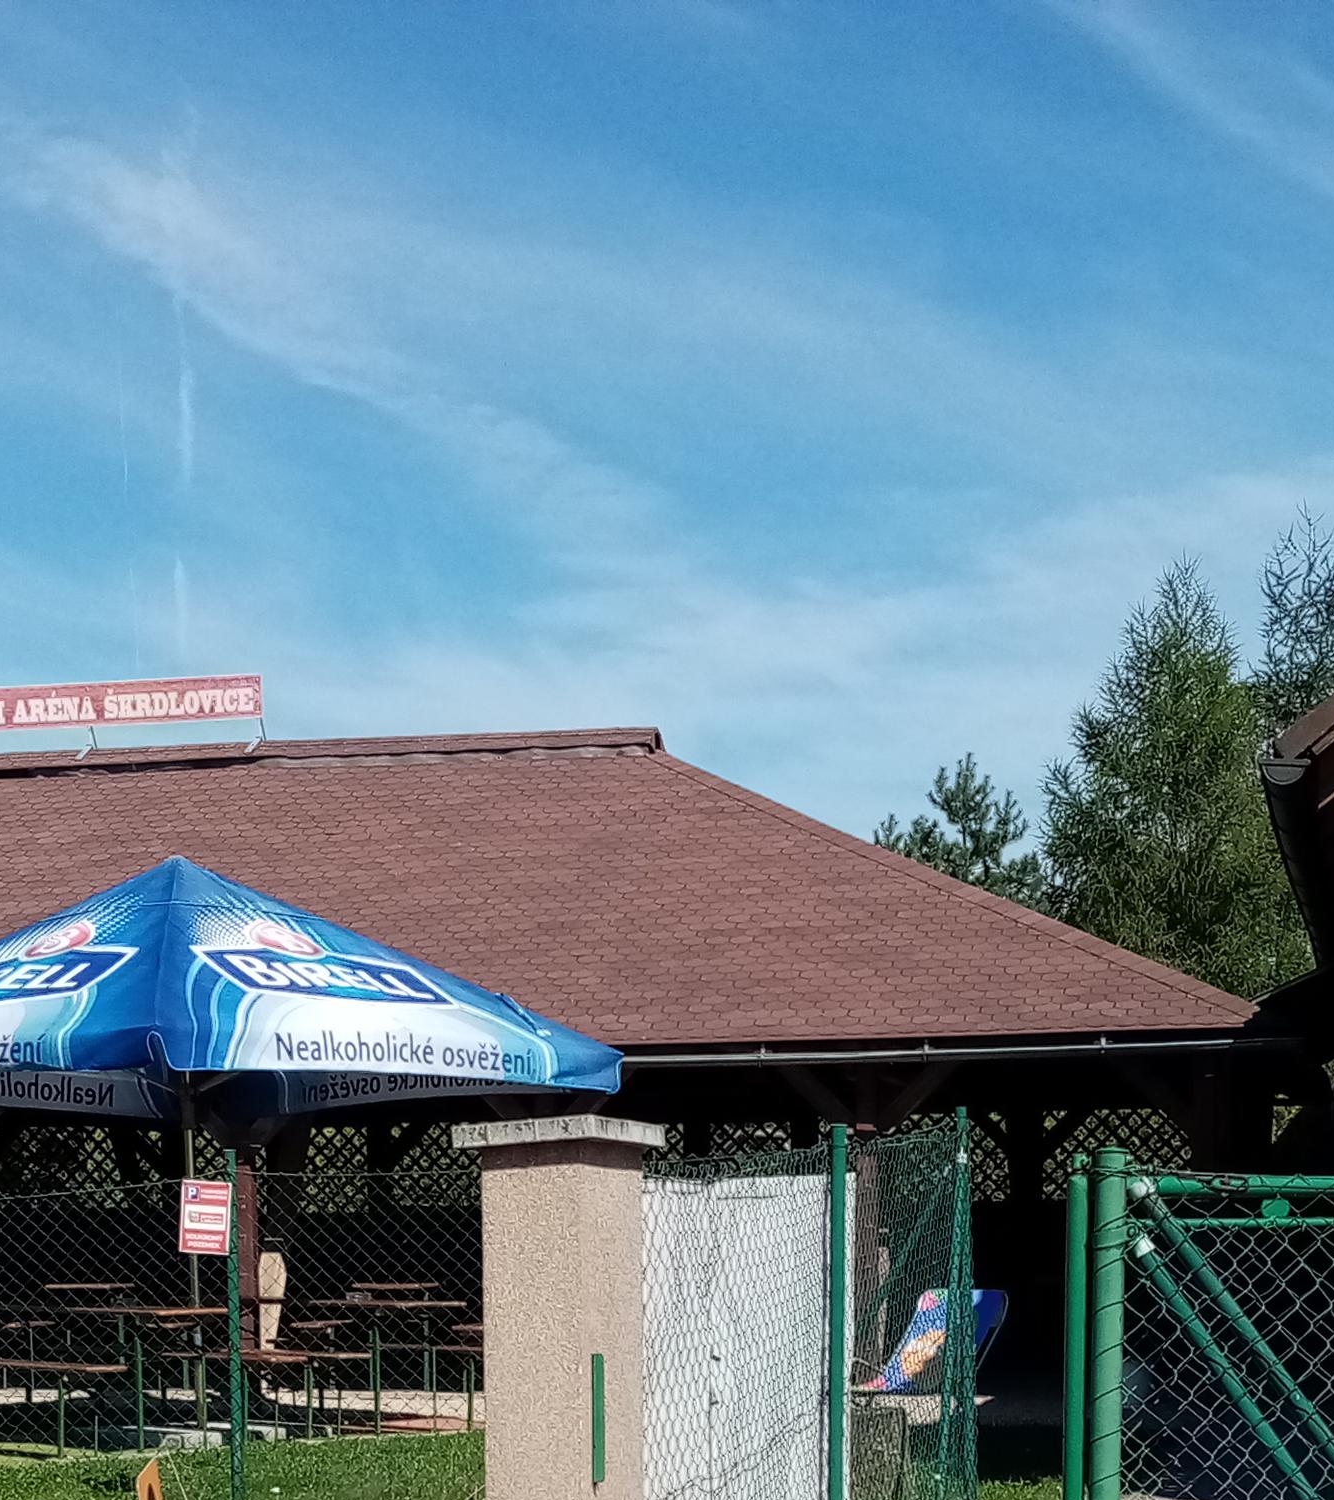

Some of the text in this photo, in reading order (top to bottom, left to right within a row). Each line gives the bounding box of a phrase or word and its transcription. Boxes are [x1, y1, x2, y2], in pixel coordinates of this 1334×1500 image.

[14, 691, 97, 723] ARÉNA
[103, 687, 256, 720] ŠKRDLOVICE
[223, 951, 435, 1000] BIRELL
[275, 1031, 534, 1076] Nealkoholické osvěžení
